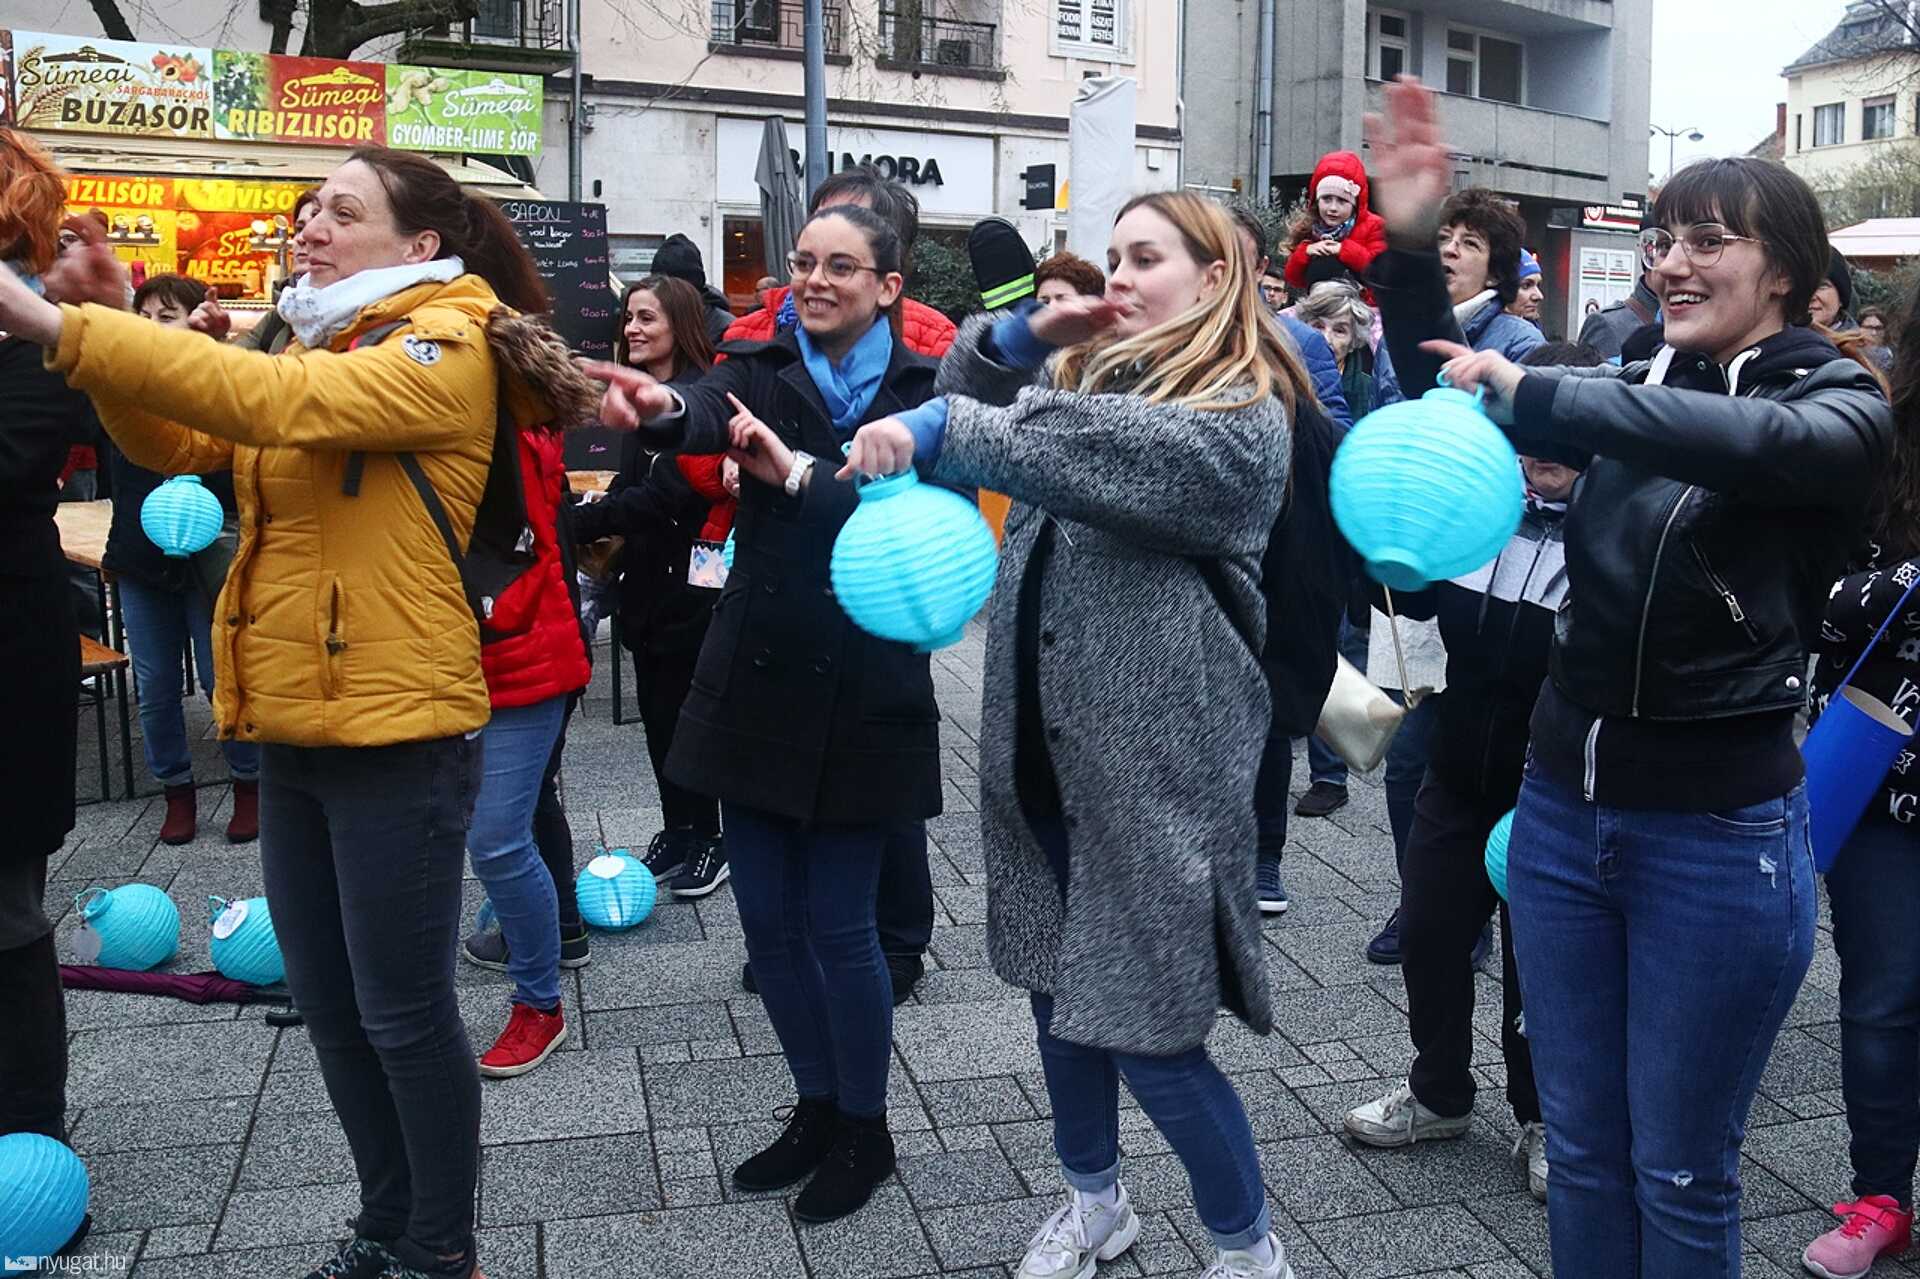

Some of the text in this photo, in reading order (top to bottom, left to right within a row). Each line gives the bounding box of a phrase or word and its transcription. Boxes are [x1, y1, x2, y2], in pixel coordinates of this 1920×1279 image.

[61, 93, 210, 131] BÚZASÖR
[281, 79, 383, 114] Sümegi
[442, 91, 535, 121] Sümegi
[228, 108, 374, 140] RIBIZLISÖR
[392, 119, 537, 151] GYÖMBÉR-LIME SÖR
